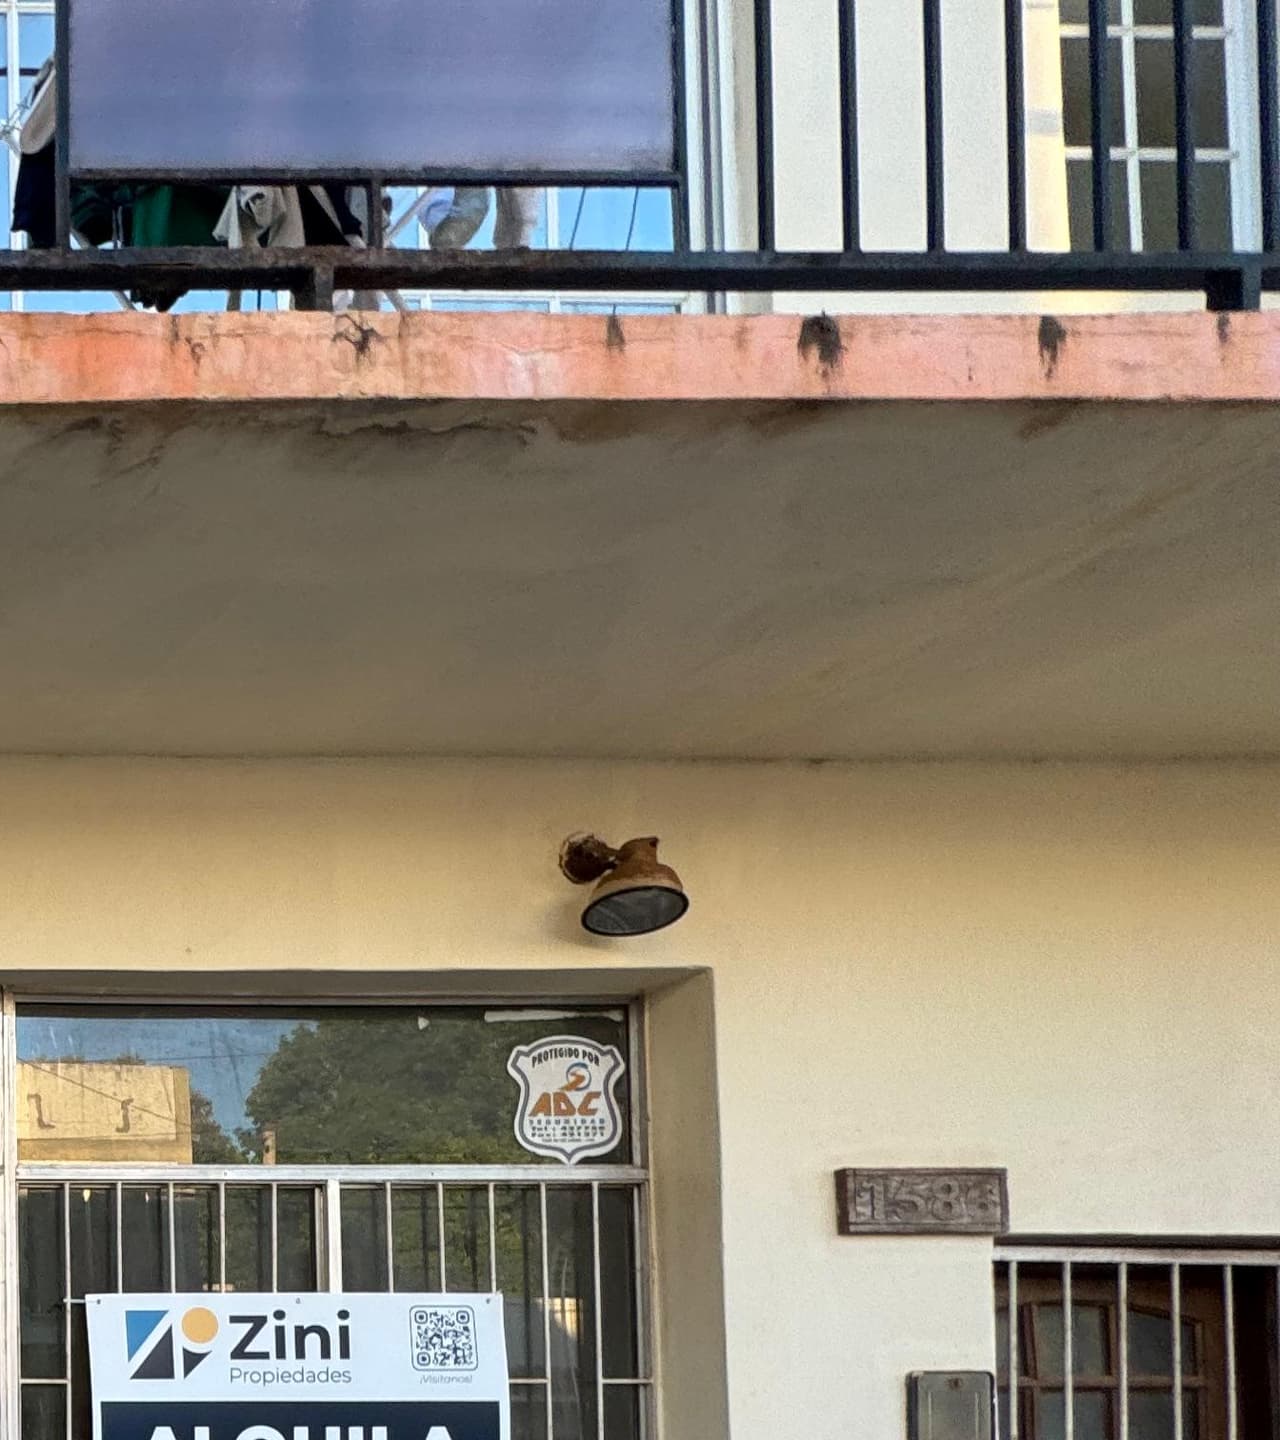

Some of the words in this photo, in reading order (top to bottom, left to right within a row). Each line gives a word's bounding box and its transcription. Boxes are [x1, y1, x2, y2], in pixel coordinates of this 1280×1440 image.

[532, 1047, 579, 1068] PROTEGIDO
[582, 1049, 600, 1066] POR
[528, 1091, 601, 1117] ADC
[229, 1309, 352, 1361] Zini
[230, 1366, 352, 1386] Propiedades
